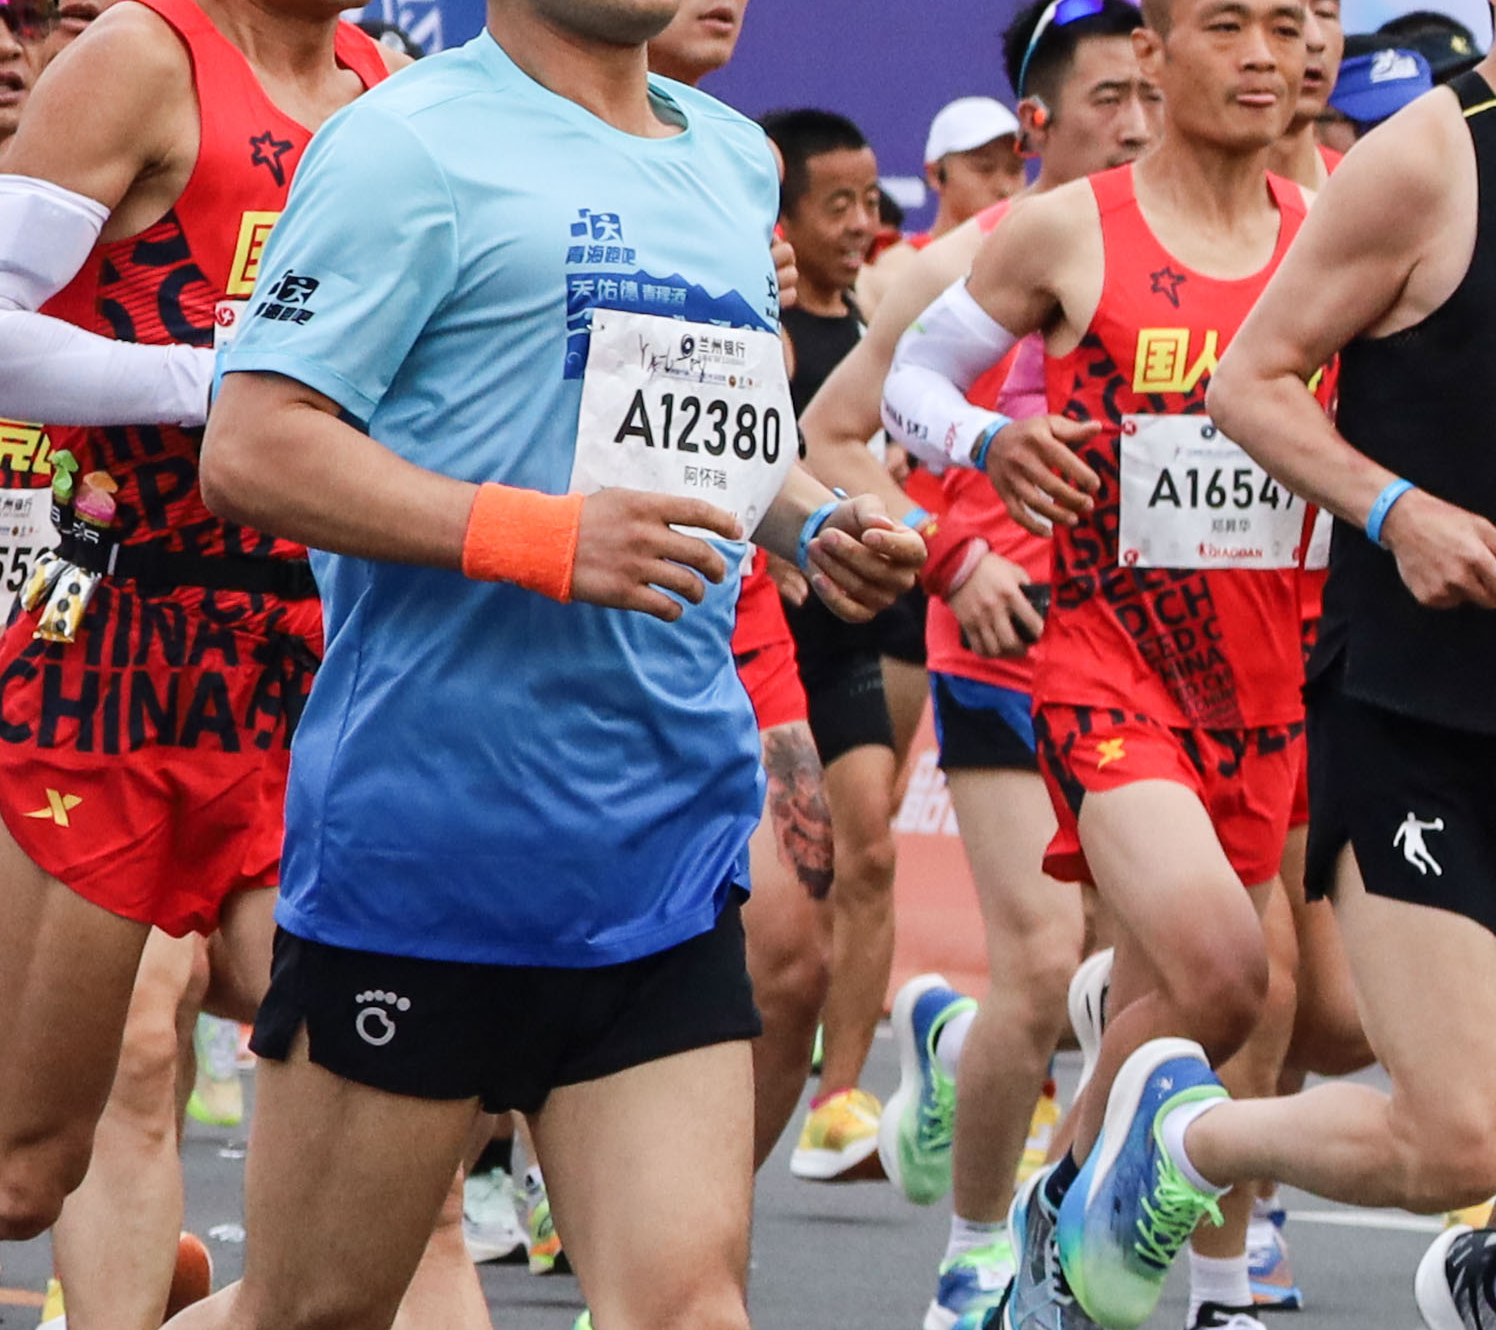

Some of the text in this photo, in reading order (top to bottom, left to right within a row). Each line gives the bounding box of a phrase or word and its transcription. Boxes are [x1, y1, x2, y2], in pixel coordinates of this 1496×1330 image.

[571, 278, 639, 303] 天佑德
[699, 336, 746, 358] 兰州银行
[613, 389, 780, 464] A12380
